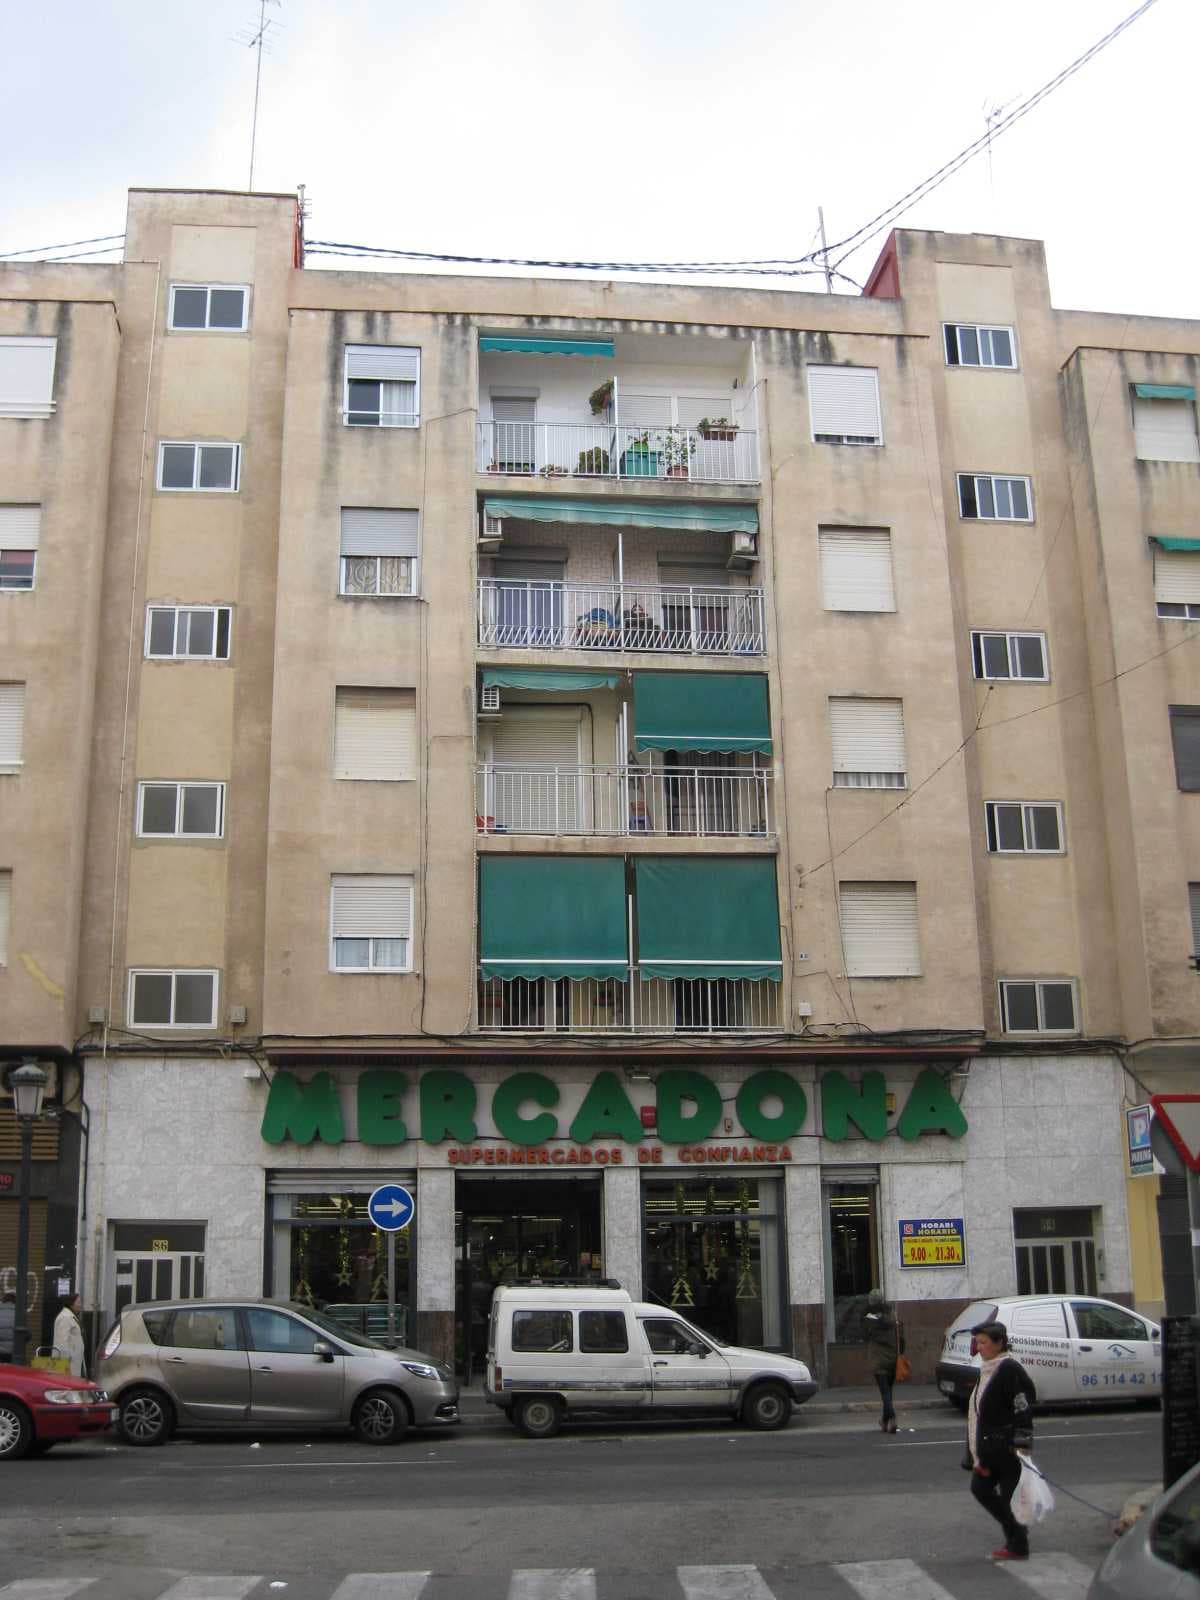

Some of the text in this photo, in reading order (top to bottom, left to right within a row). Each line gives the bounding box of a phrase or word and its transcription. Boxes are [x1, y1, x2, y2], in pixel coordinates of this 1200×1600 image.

[260, 1069, 969, 1146] MERCADONA
[447, 1145, 794, 1165] SUPERMERCADOS DE CONFIANZA
[917, 1228, 957, 1236] HORARIO
[910, 1246, 926, 1261] 9.00
[935, 1245, 956, 1261] 21.30
[1009, 1335, 1070, 1349] deosistemas.es
[1020, 1357, 1069, 1368] SIN CUOTAS
[1081, 1374, 1098, 1385] 96
[1103, 1373, 1125, 1385] 114
[1129, 1372, 1146, 1384] 42
